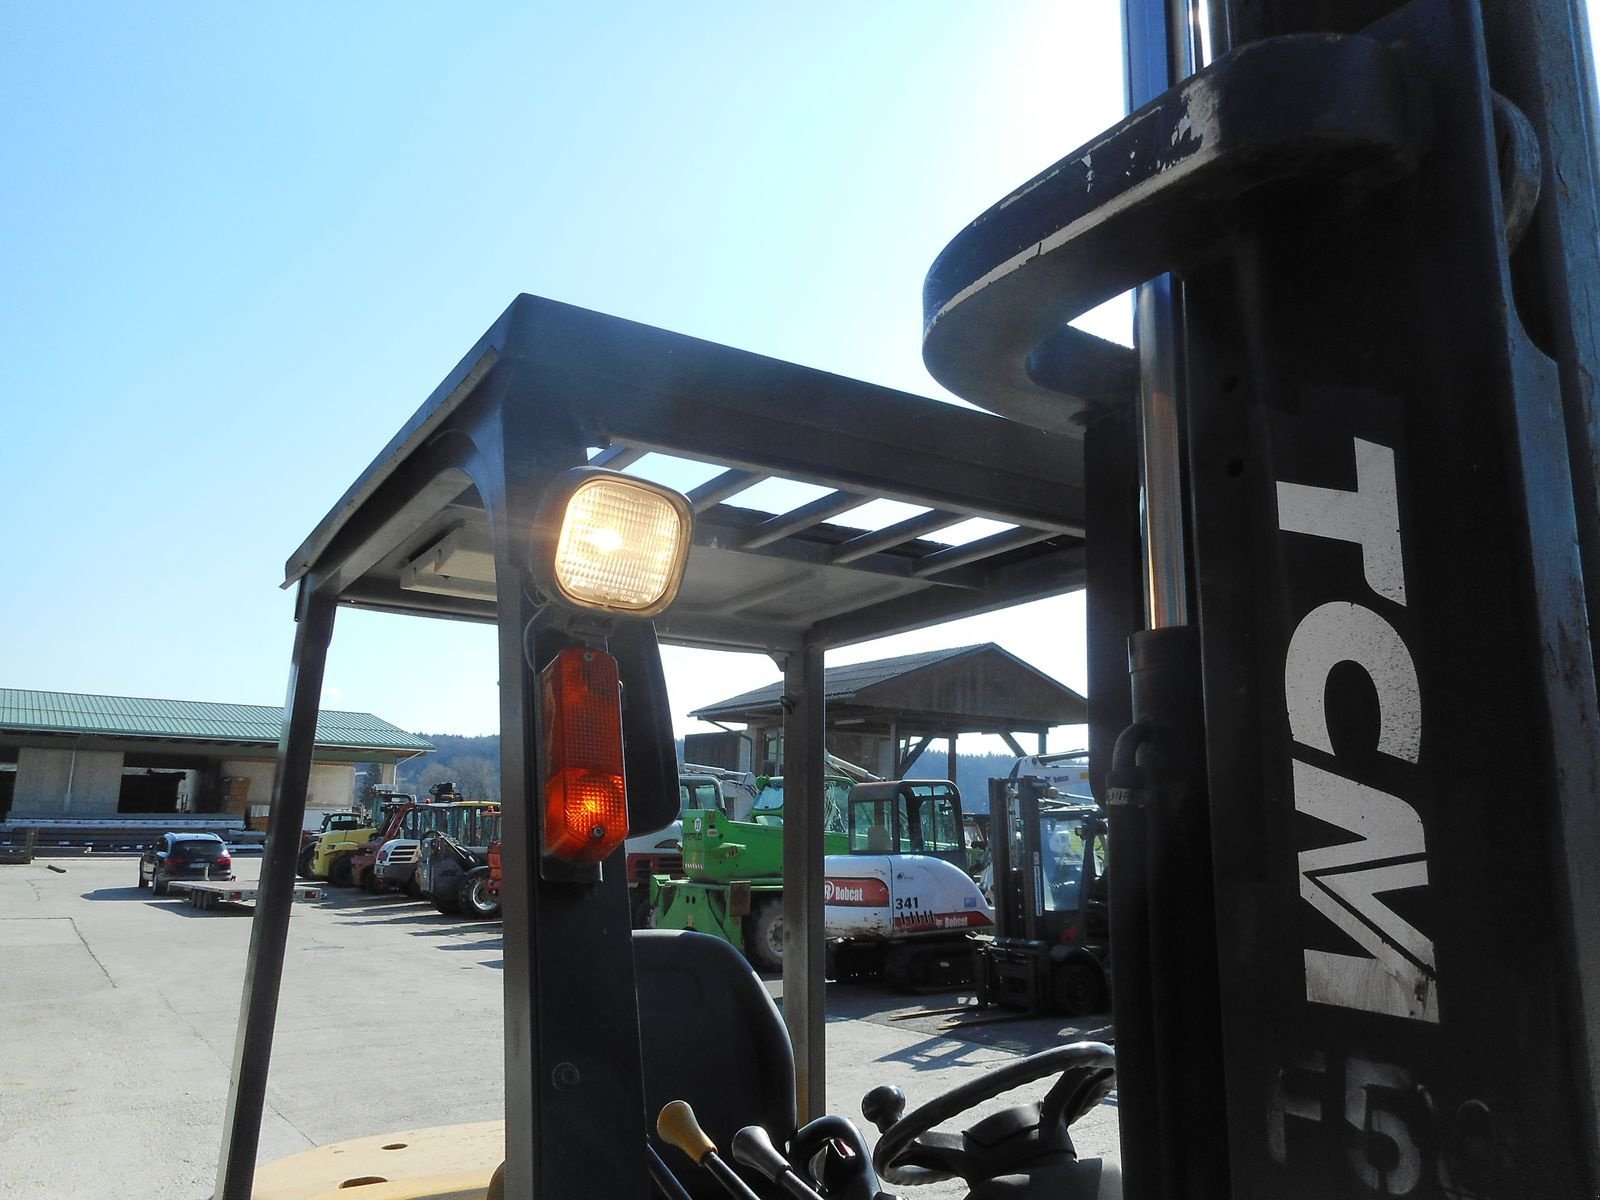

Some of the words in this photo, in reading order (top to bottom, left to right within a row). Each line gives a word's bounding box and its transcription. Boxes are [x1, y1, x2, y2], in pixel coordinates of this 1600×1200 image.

[1275, 436, 1440, 1024] TCM
[835, 886, 863, 901] Bobcat
[895, 896, 919, 910] 341
[944, 916, 968, 928] Bobcat
